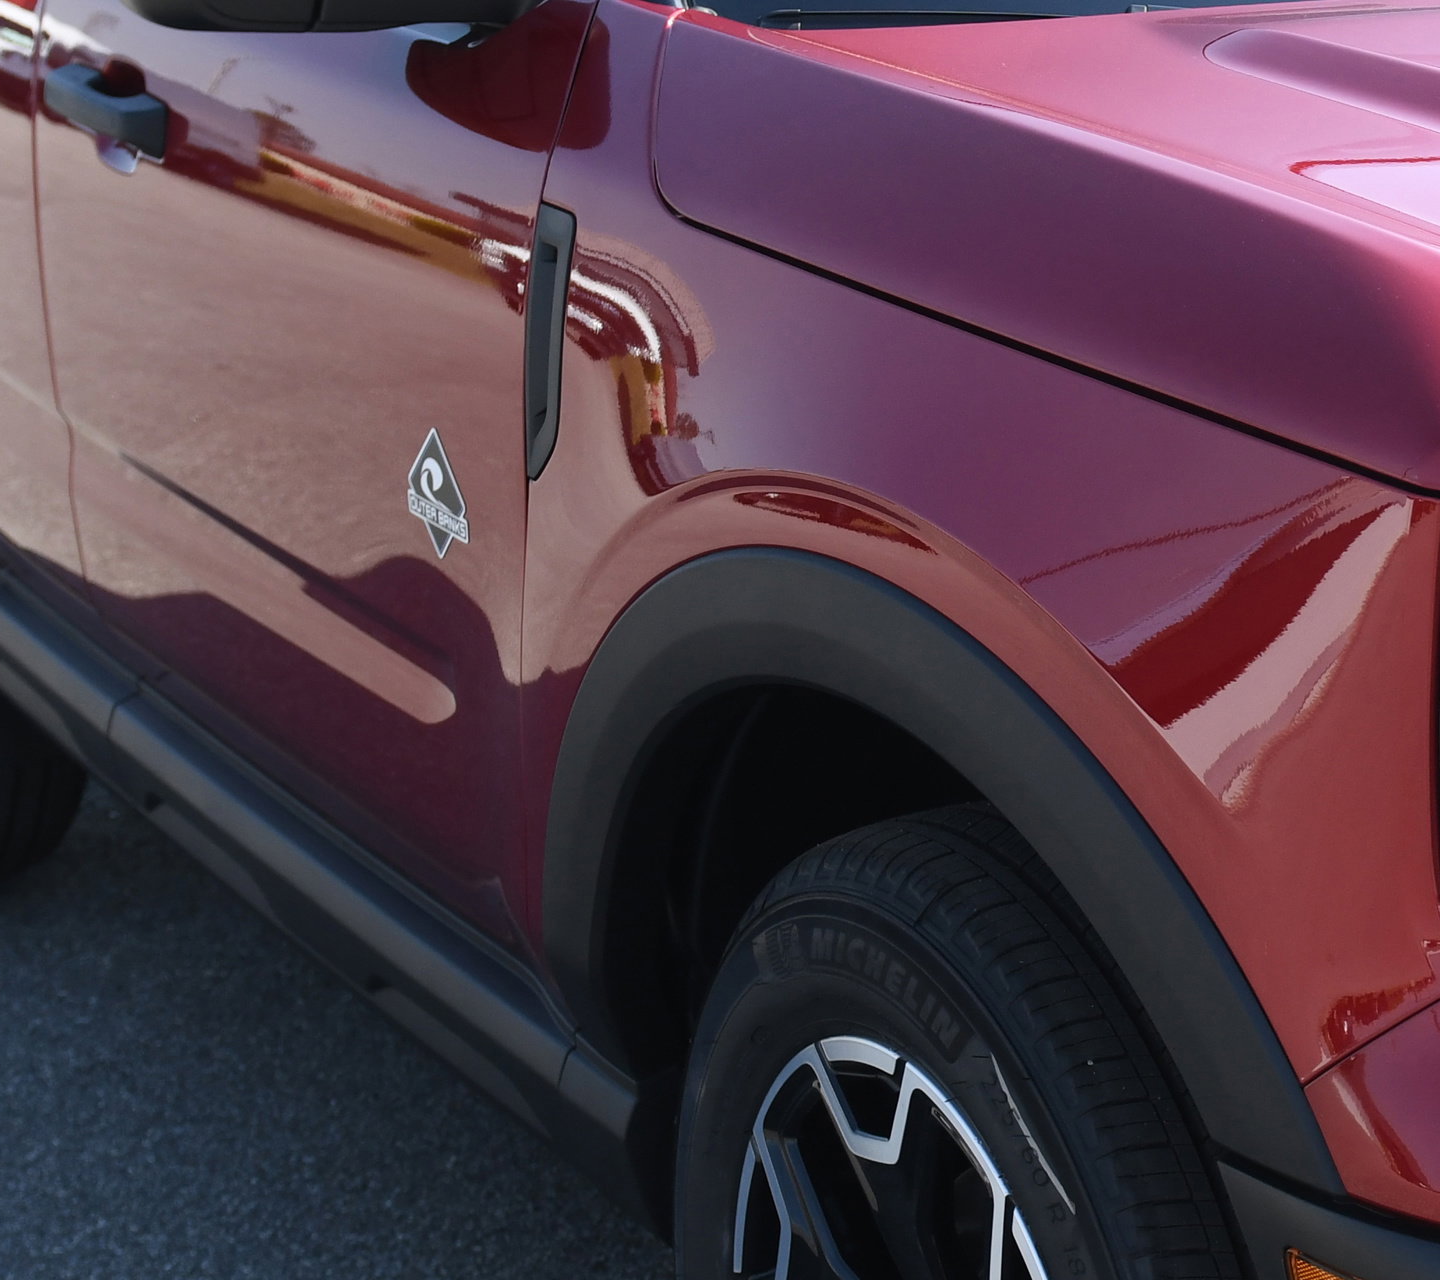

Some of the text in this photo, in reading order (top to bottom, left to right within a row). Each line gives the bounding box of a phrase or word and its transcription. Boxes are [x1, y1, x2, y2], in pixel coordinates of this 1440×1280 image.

[410, 496, 467, 538] OUTER BANKS
[809, 926, 961, 1050] MICHELIN
